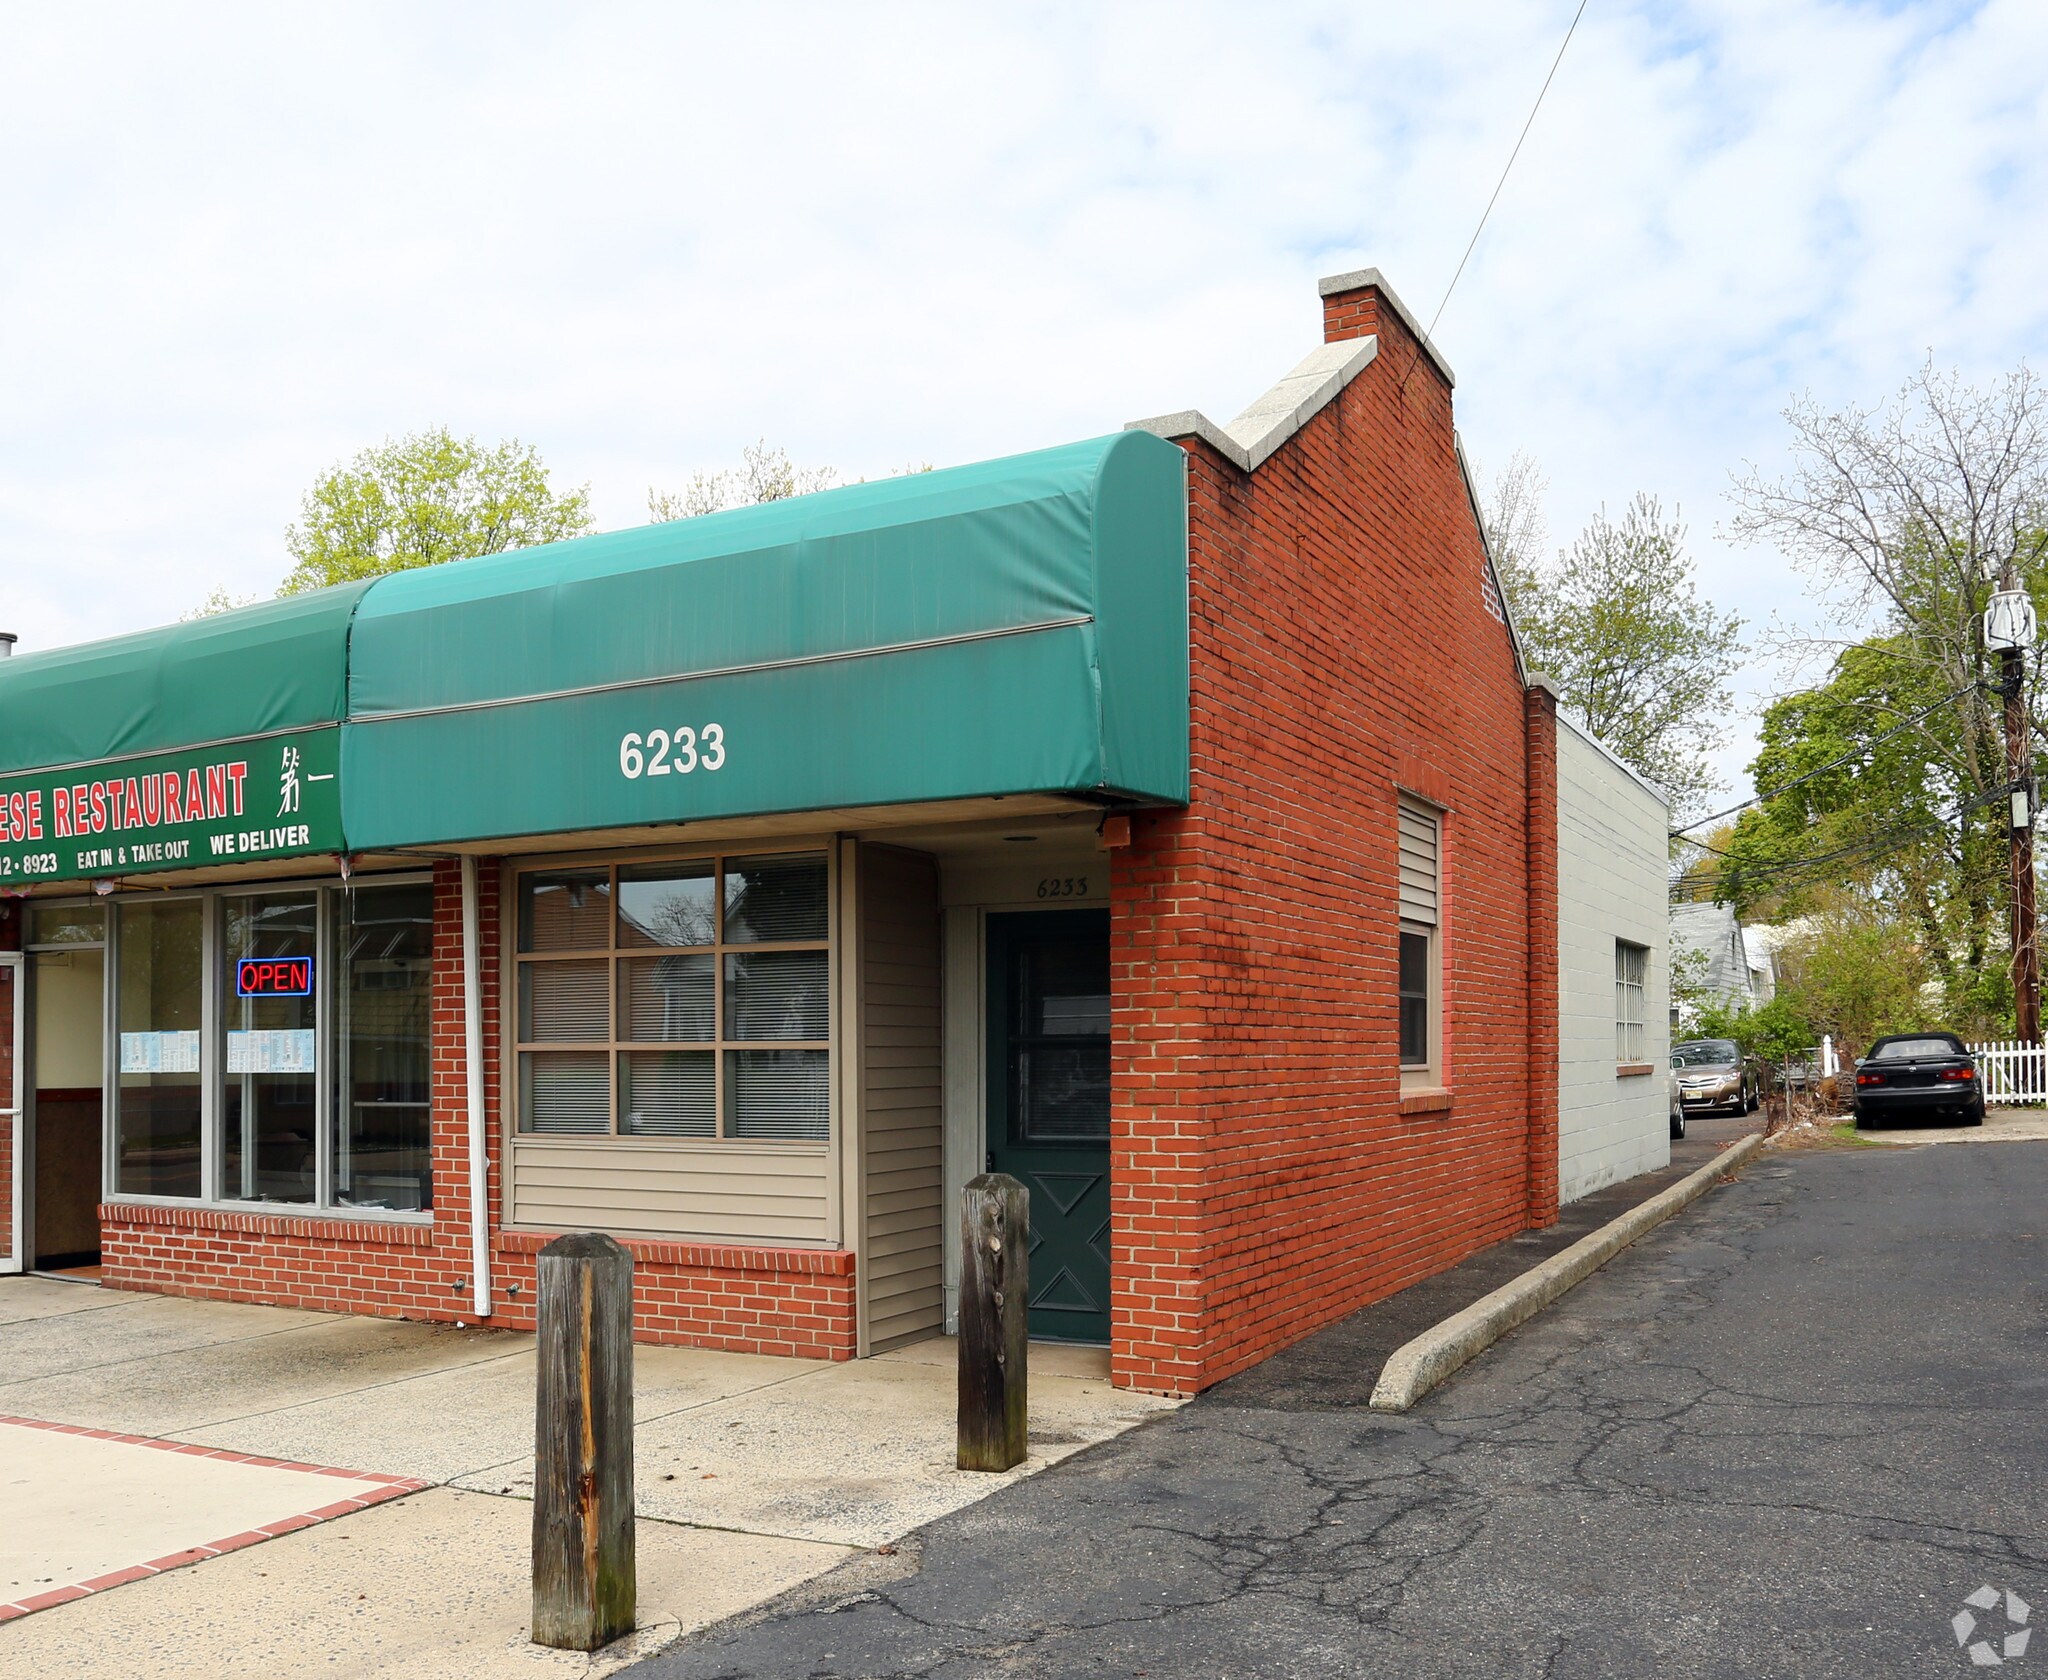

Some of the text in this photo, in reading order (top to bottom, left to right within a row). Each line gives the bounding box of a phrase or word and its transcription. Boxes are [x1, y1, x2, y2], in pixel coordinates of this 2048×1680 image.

[620, 722, 726, 779] 6233
[53, 761, 247, 838] RESTAURANT
[77, 850, 98, 870] EAT
[100, 848, 113, 867] IN
[118, 847, 127, 865] &
[131, 842, 163, 863] TAKE
[165, 840, 190, 860] OUT
[210, 833, 235, 855] WE
[239, 824, 310, 852] DELIVER
[1037, 876, 1088, 898] 6233
[241, 963, 307, 991] OPEN
